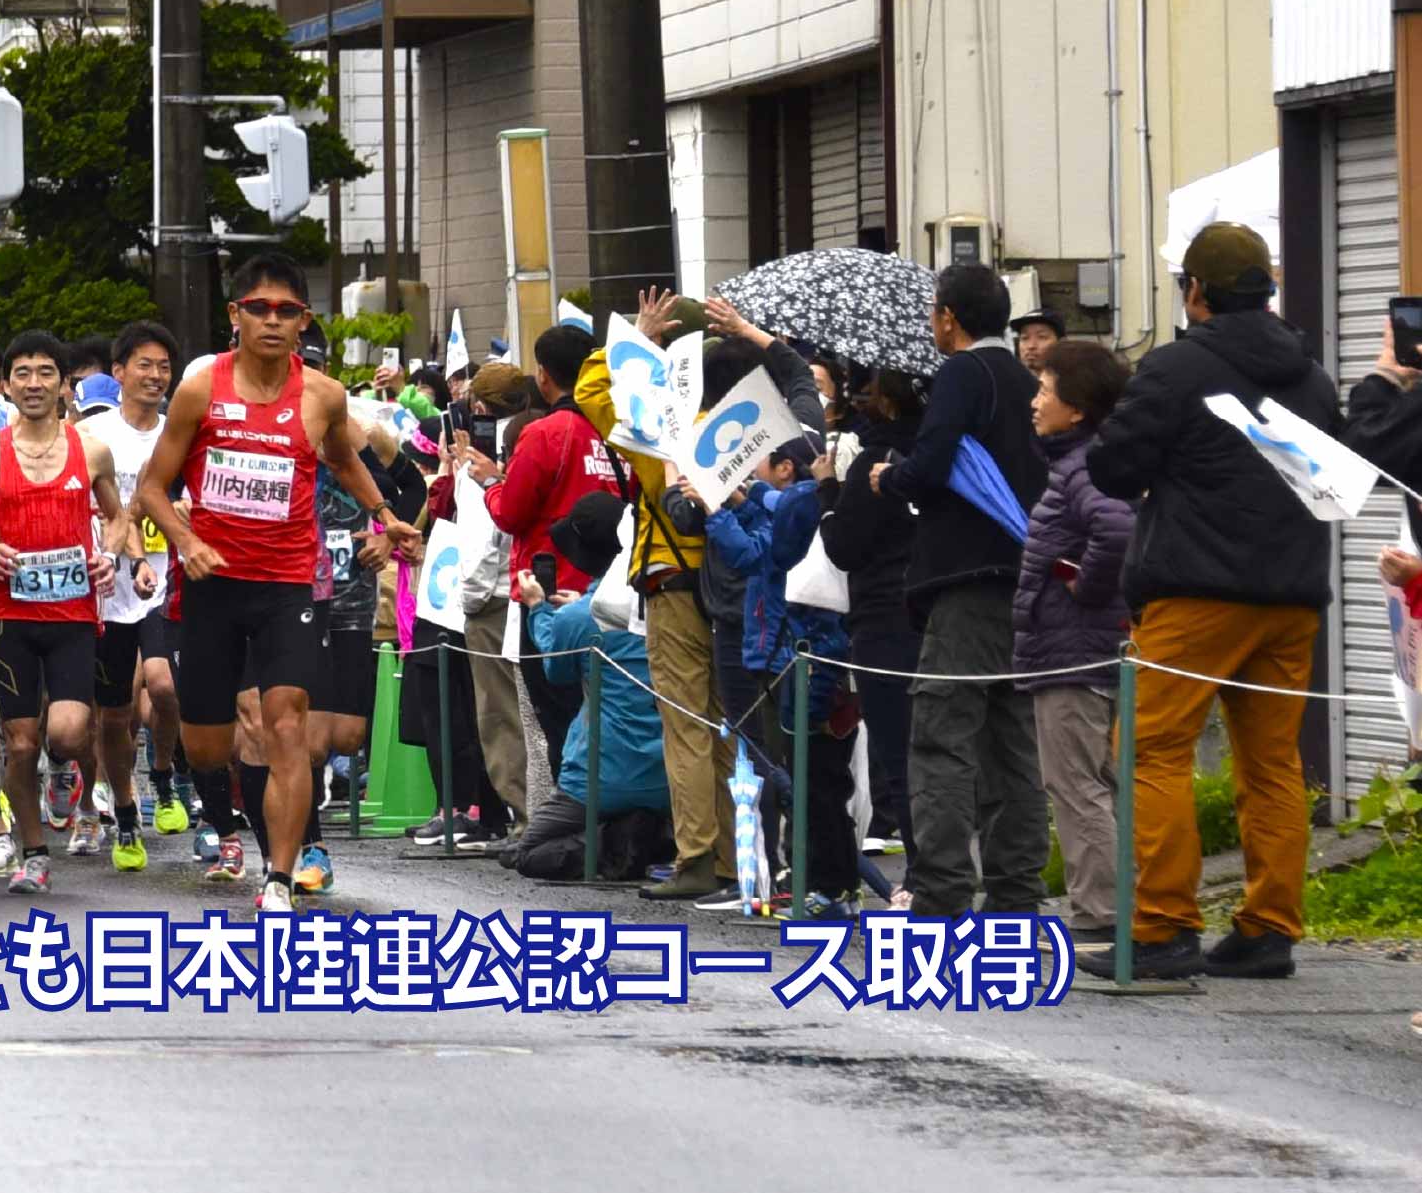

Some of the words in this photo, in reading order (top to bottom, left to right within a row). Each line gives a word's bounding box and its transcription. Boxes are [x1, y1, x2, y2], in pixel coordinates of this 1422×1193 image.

[203, 470, 291, 505] 川内優輝
[14, 563, 86, 593] A3176
